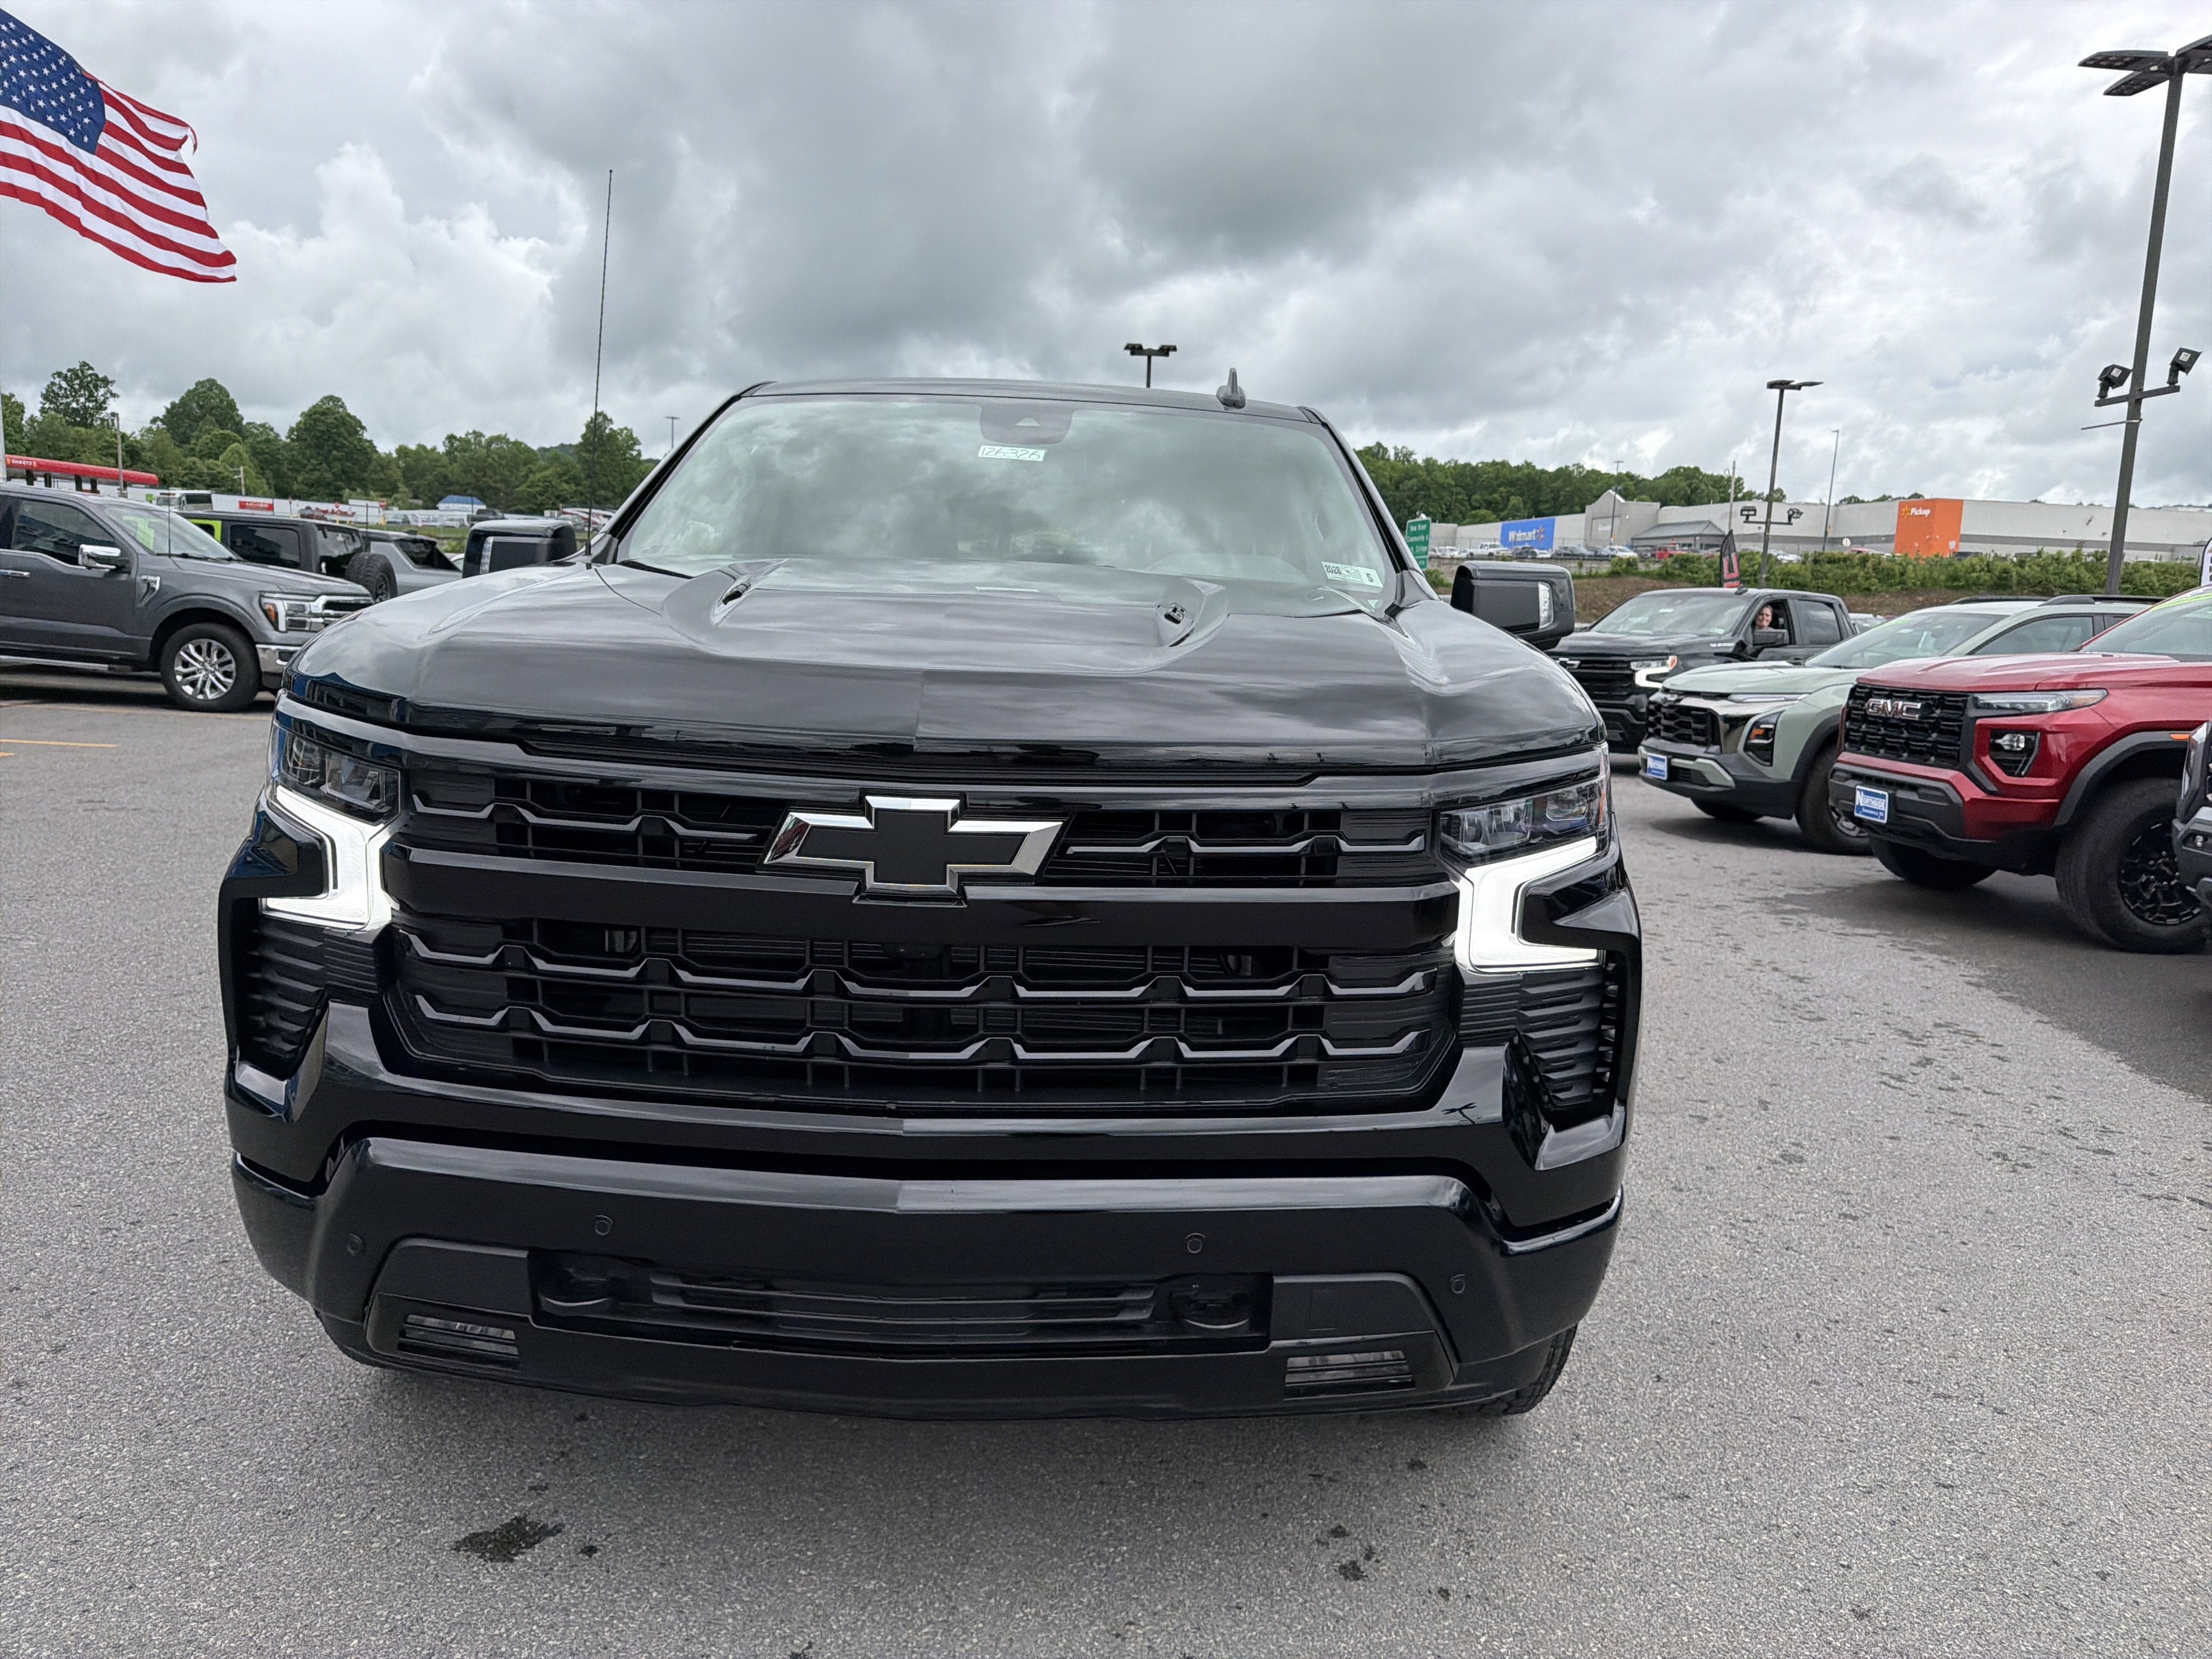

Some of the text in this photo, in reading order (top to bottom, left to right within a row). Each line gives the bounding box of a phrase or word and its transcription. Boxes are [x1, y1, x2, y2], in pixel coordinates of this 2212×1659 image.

[1910, 507, 1931, 518] Pickup
[1509, 528, 1536, 542] Walmart
[1365, 572, 1374, 583] 5
[1866, 698, 1921, 720] GMC
